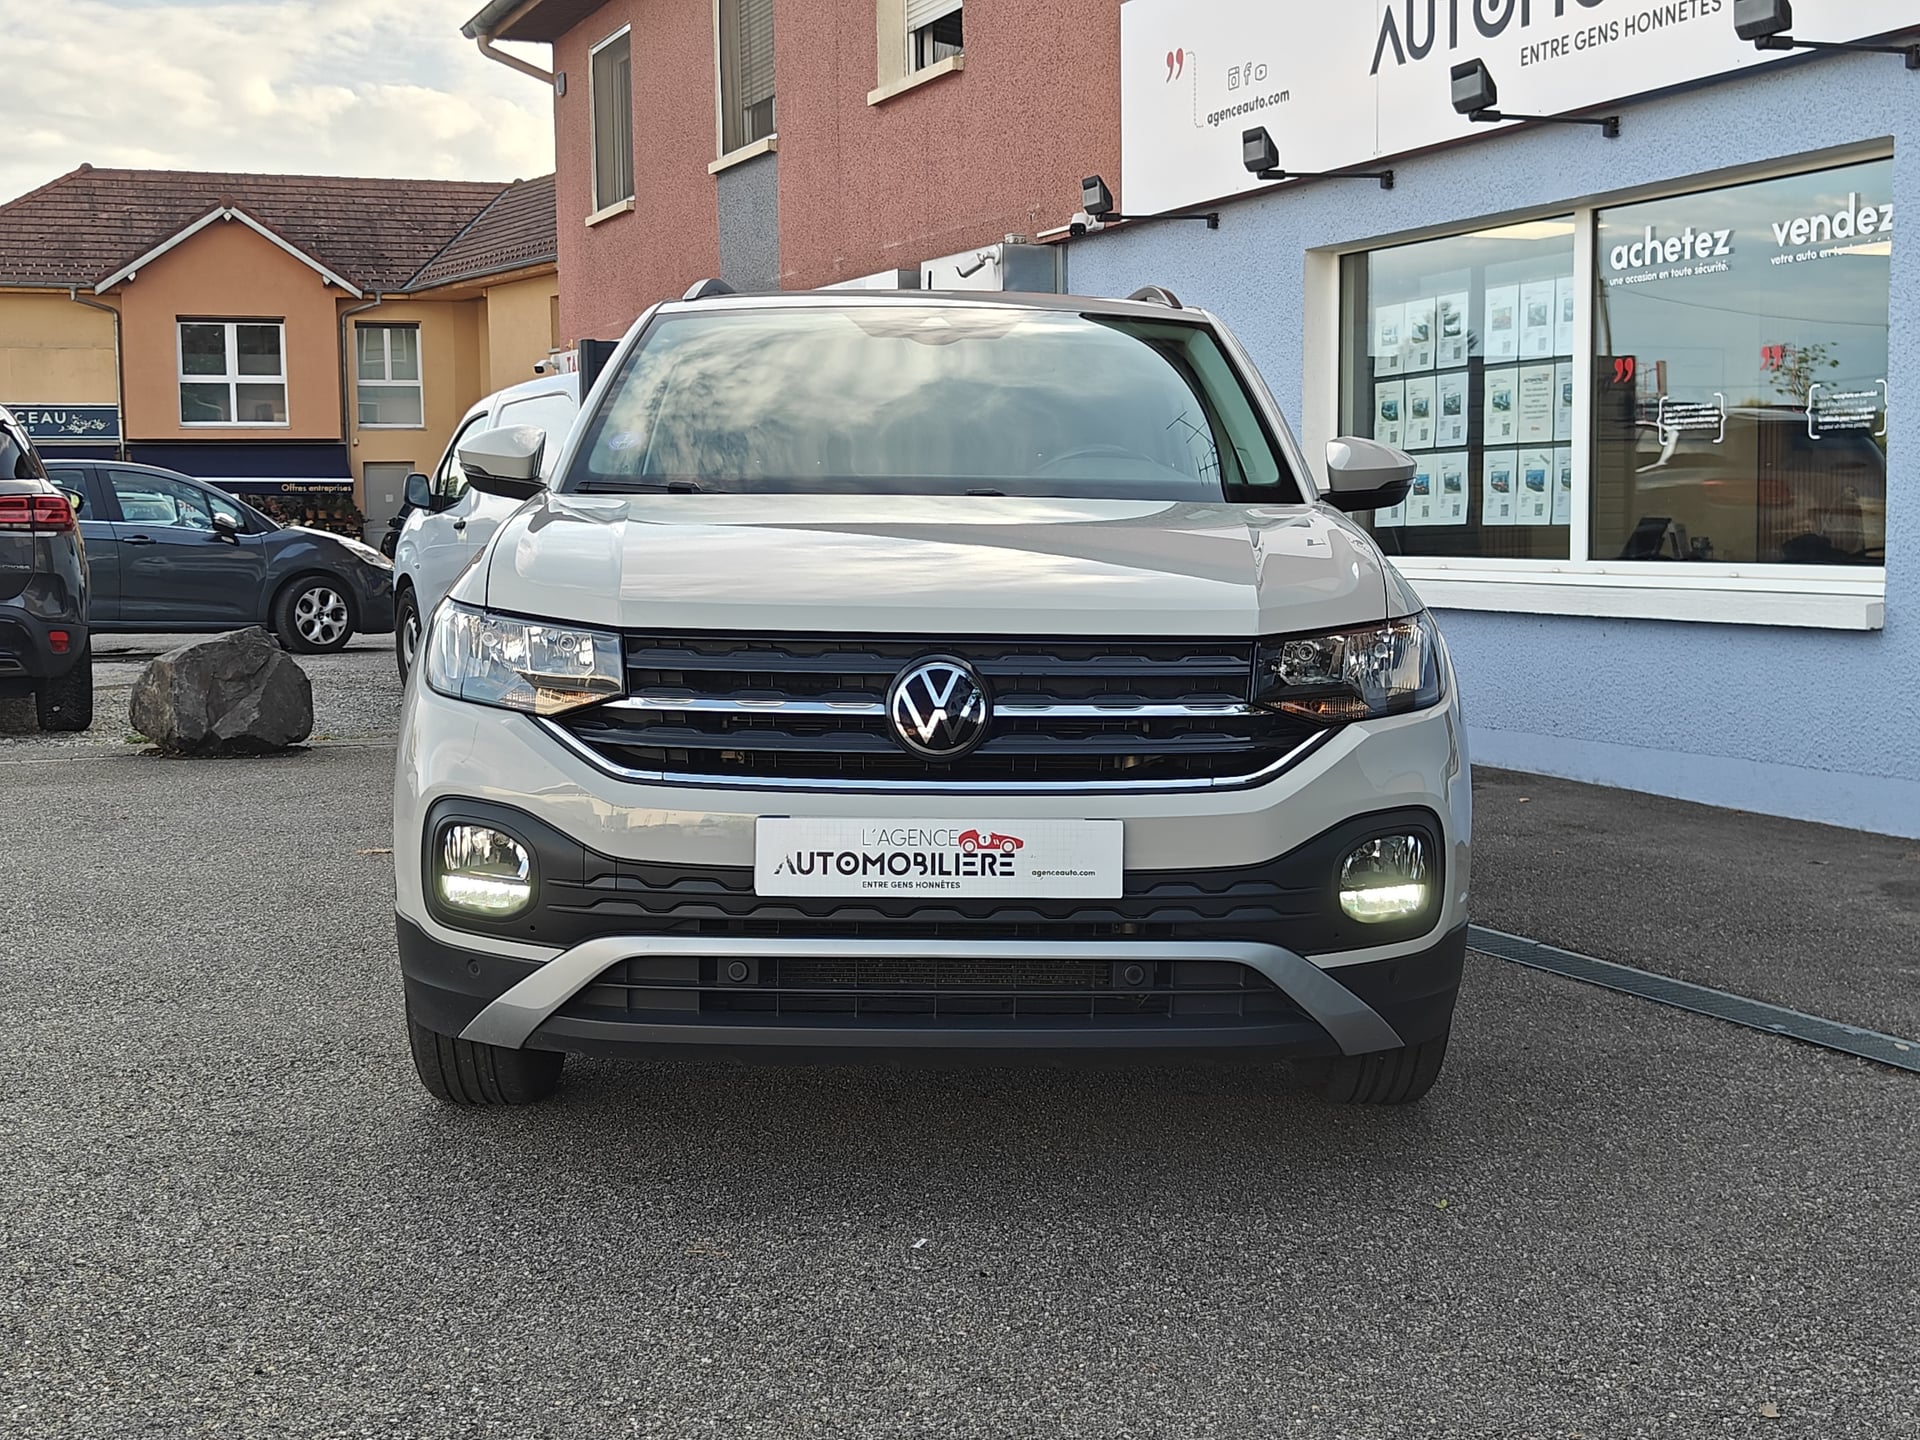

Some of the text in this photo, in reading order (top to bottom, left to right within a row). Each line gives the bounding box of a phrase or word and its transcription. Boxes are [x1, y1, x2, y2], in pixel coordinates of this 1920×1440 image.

[1369, 0, 1606, 76] AUTO
[1520, 35, 1570, 67] ENTRE
[1574, 21, 1619, 51] GENS
[1206, 89, 1290, 127] agenceauto.com
[1771, 191, 1893, 247] vendez
[1610, 225, 1731, 271] achetez
[1770, 253, 1794, 265] votre
[1796, 249, 1817, 262] auto
[1609, 278, 1624, 286] une
[1625, 270, 1657, 284] occasion
[1659, 270, 1669, 280] en
[1671, 266, 1692, 278] toute
[281, 483, 352, 494] Offres entreprises
[862, 828, 960, 847] L'AGENCE
[1031, 869, 1096, 878] agenceauto.com
[862, 879, 961, 889] ENTRE GENS HONNÊTES
